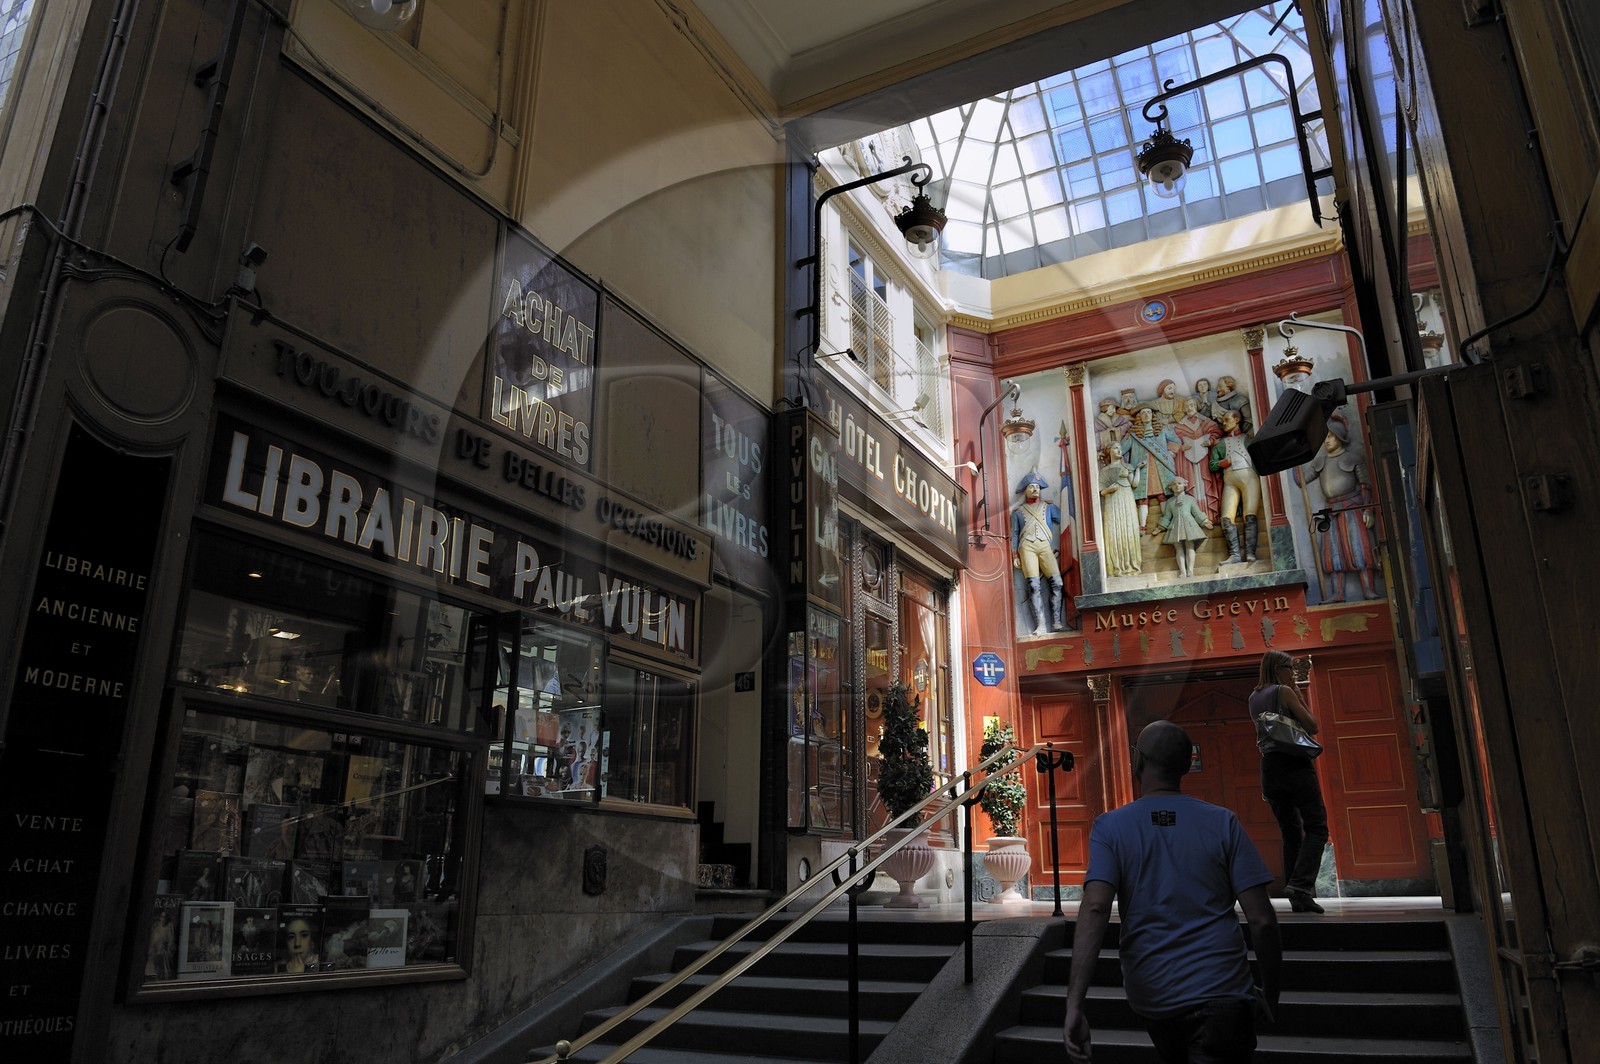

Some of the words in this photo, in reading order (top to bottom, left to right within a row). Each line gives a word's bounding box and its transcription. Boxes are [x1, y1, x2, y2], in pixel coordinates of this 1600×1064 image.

[501, 279, 594, 365] ACHAT
[531, 354, 564, 392] DE
[491, 376, 590, 466] LIVRES
[274, 339, 440, 444] TOUJOURS
[456, 429, 492, 468] DE
[504, 450, 587, 511] BELLES
[597, 495, 698, 561] OCCASIONS
[712, 413, 762, 474] TOUS
[726, 470, 752, 500] LES
[892, 450, 959, 537] CHOPIN
[222, 431, 495, 590] LIBRAIRIE
[513, 541, 589, 620] PAUL
[599, 572, 686, 650] VULIN
[707, 494, 769, 559] LIVRES
[45, 551, 147, 590] LIBRAIRIE
[36, 597, 139, 632] ANCIENNE
[1095, 606, 1177, 631] Musée
[1193, 592, 1291, 619] Grévin
[71, 642, 91, 656] ET
[24, 666, 124, 698] MODERNE
[15, 814, 83, 832] VENTE
[8, 858, 74, 873] ACHAT
[3, 902, 77, 916] CHANGE
[4, 944, 71, 960] LIVRES
[9, 985, 30, 997] ET
